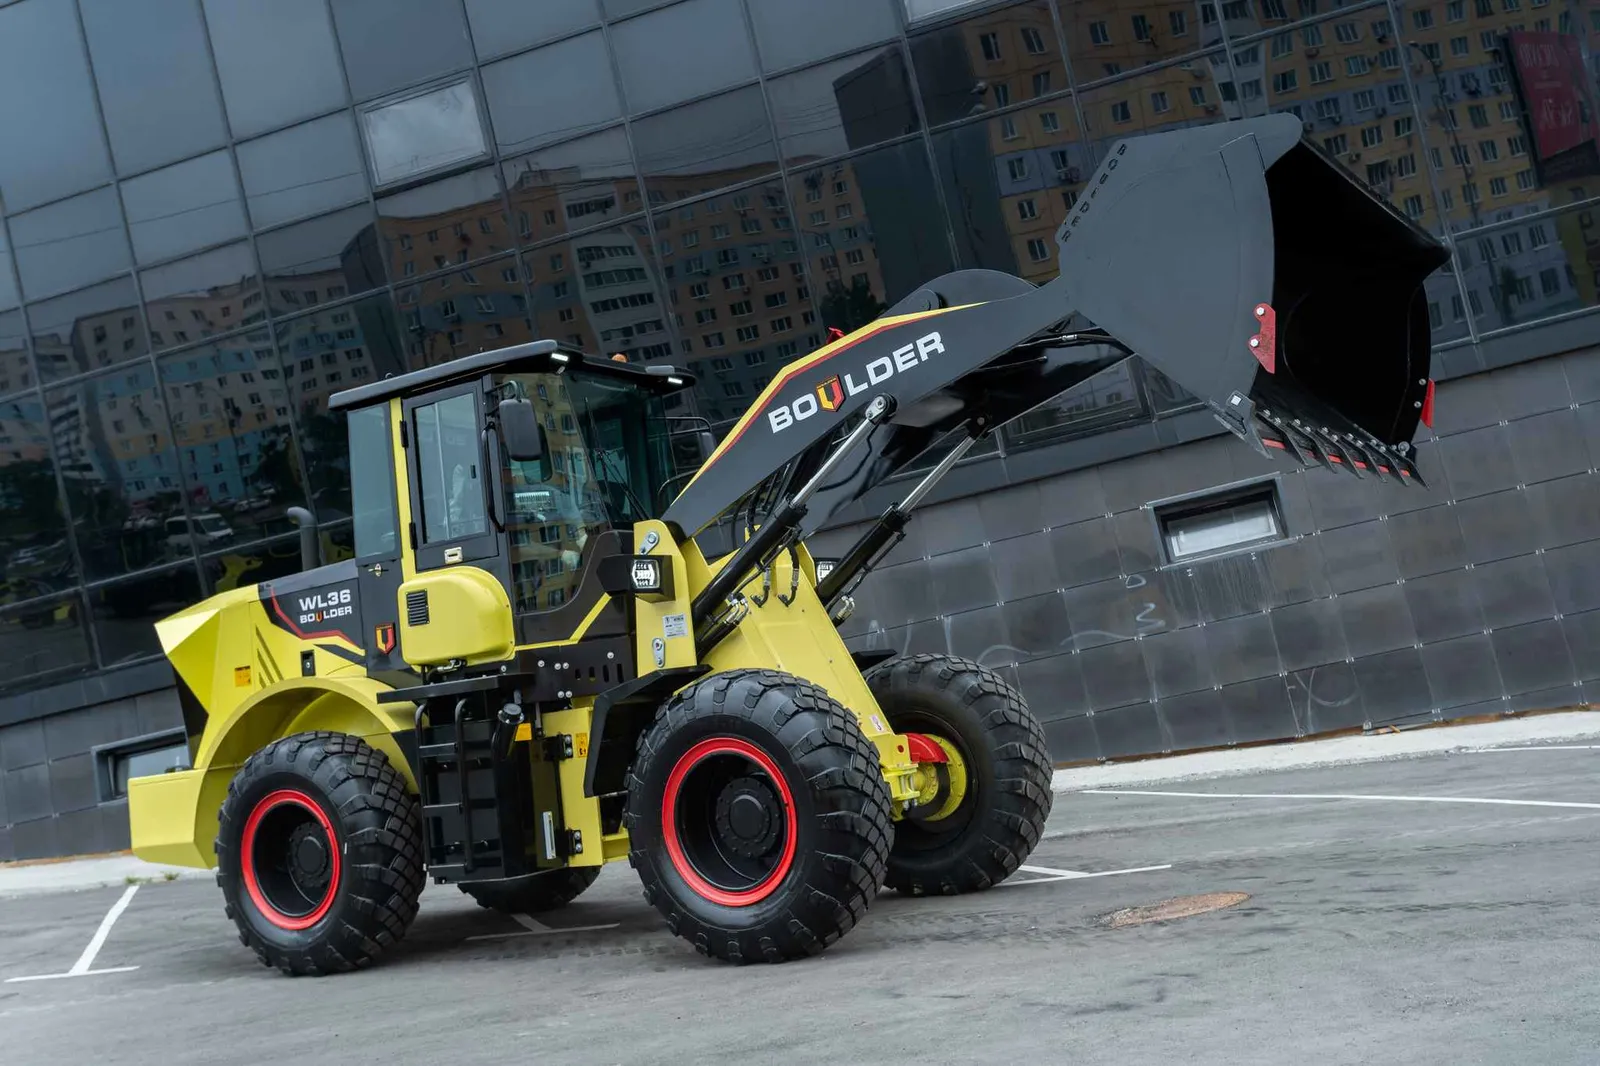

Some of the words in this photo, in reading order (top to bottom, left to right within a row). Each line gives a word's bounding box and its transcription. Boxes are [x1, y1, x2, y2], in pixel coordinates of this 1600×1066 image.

[767, 331, 946, 434] BOULDER
[298, 588, 351, 612] WL36
[299, 605, 353, 624] BOULDER
